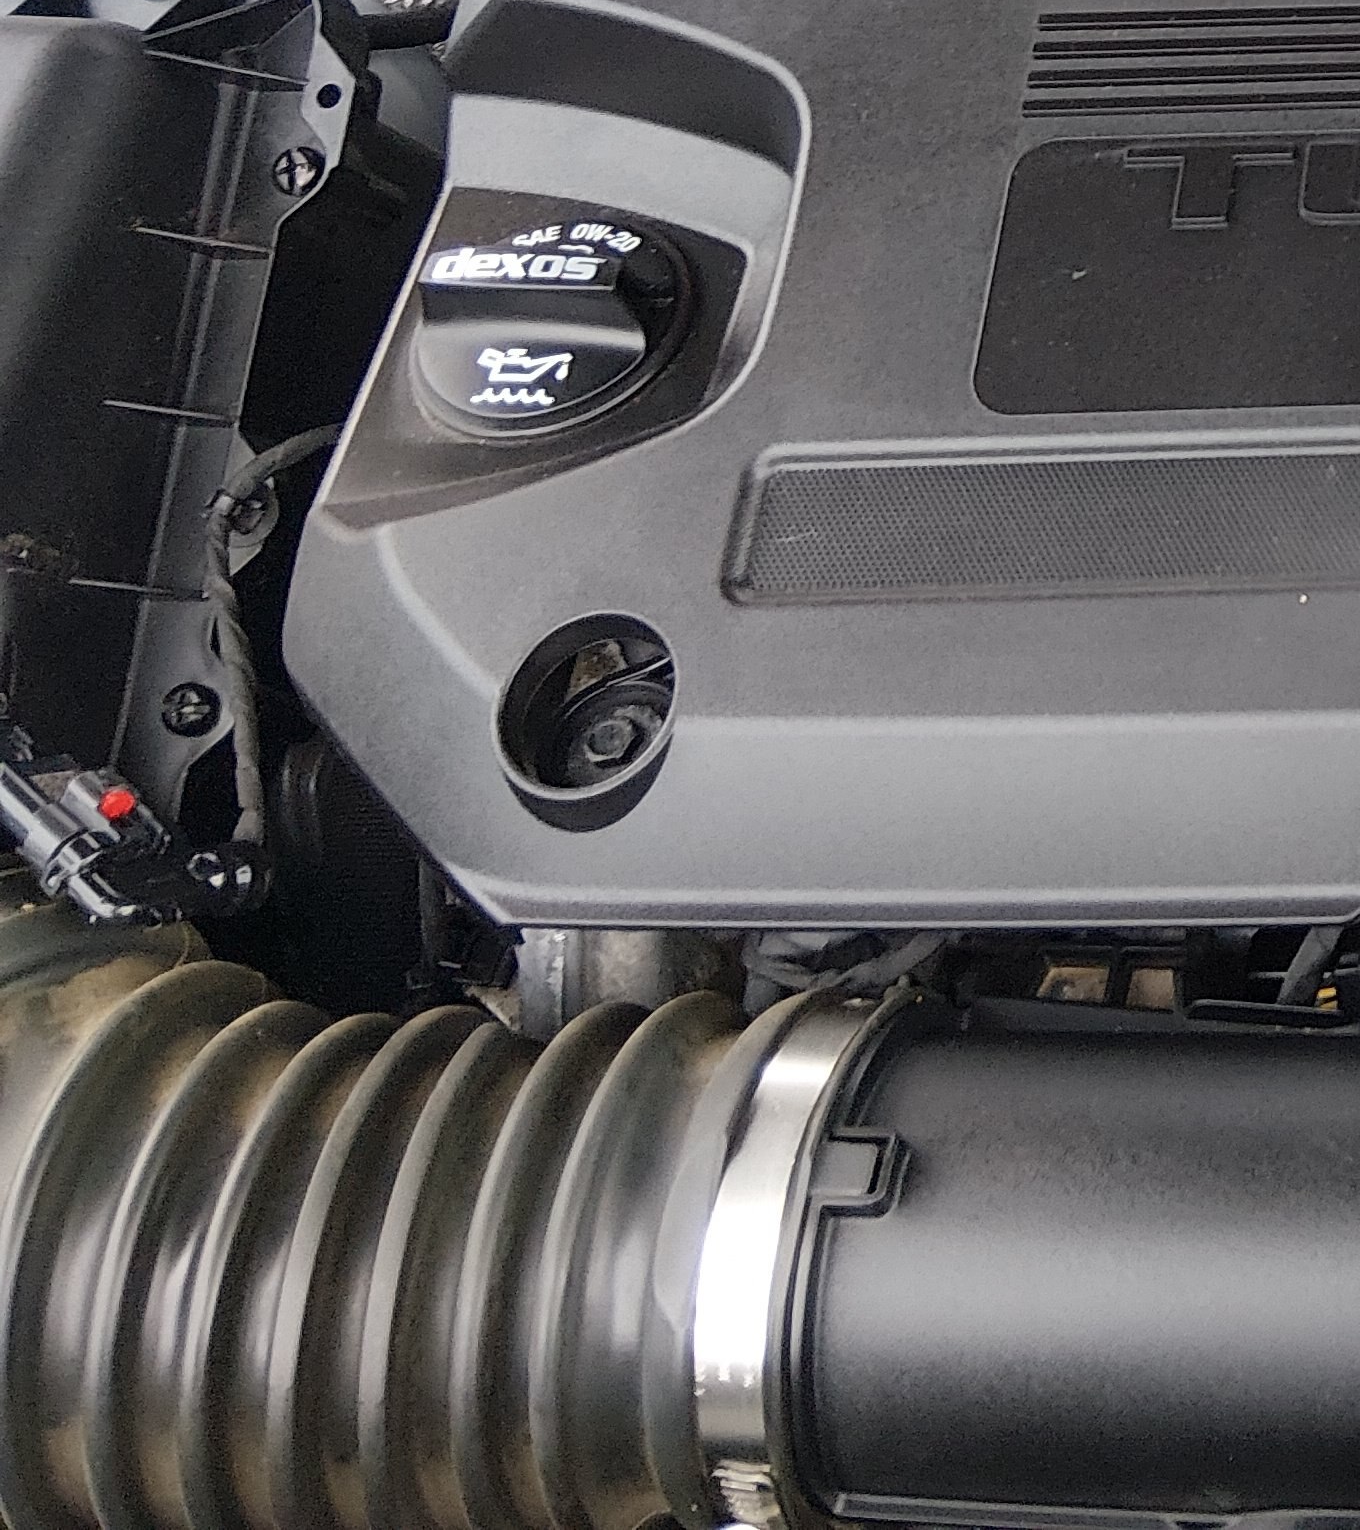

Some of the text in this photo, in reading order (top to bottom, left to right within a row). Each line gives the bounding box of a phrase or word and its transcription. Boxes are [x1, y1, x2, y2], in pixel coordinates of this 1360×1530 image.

[511, 222, 643, 253] SAE 0W-20
[431, 247, 608, 281] dexos
